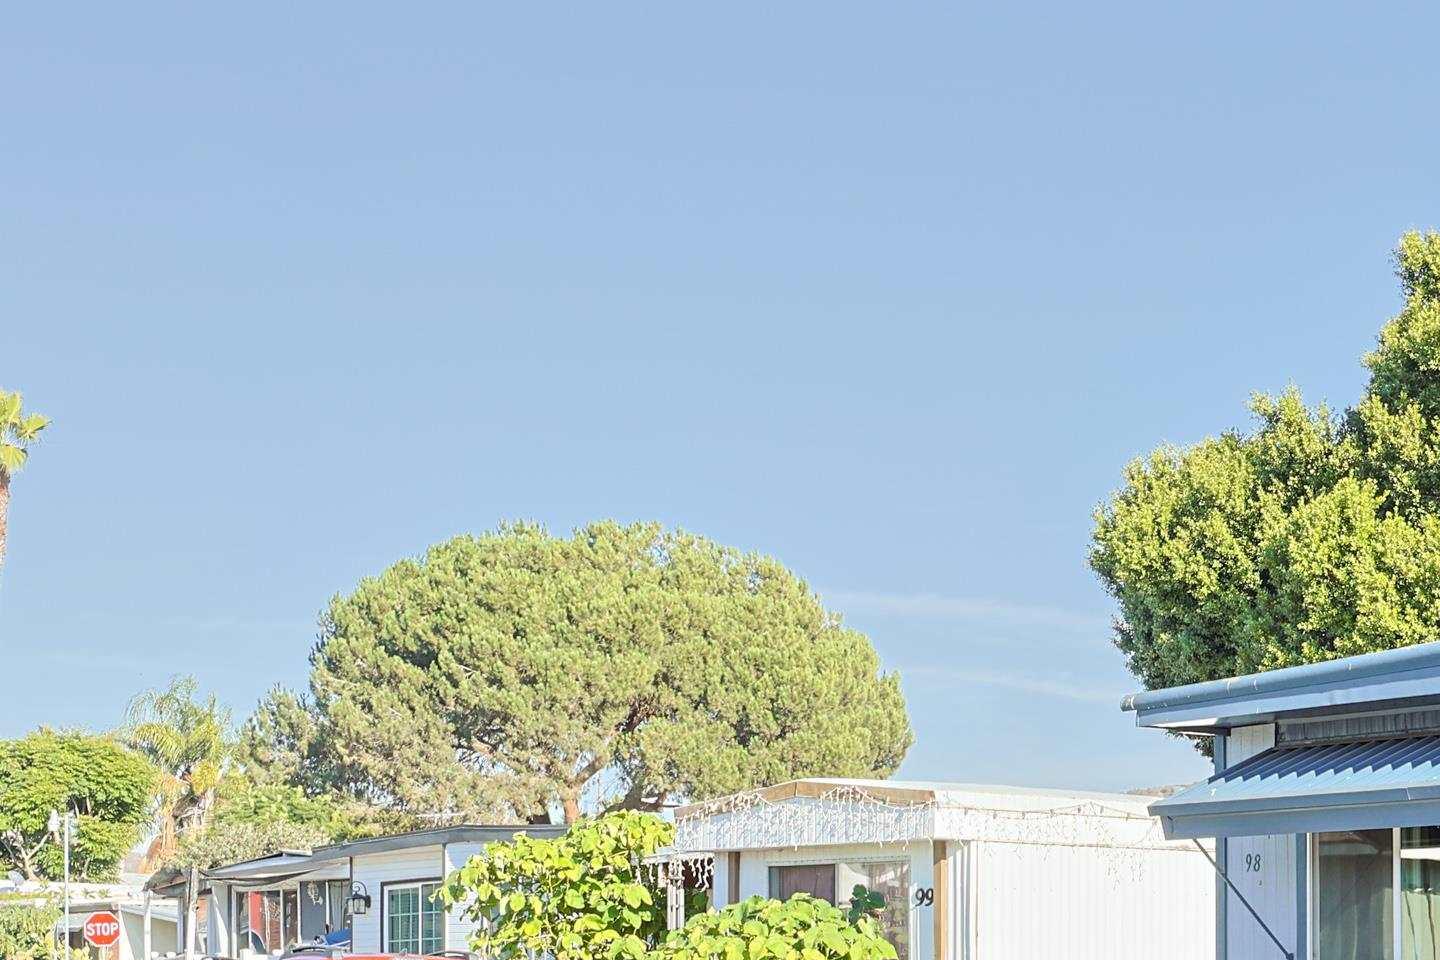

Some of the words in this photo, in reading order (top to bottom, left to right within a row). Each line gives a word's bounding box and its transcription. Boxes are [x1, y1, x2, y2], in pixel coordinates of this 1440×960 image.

[1245, 853, 1261, 873] 98
[914, 887, 934, 907] 99
[86, 922, 119, 937] STOP
